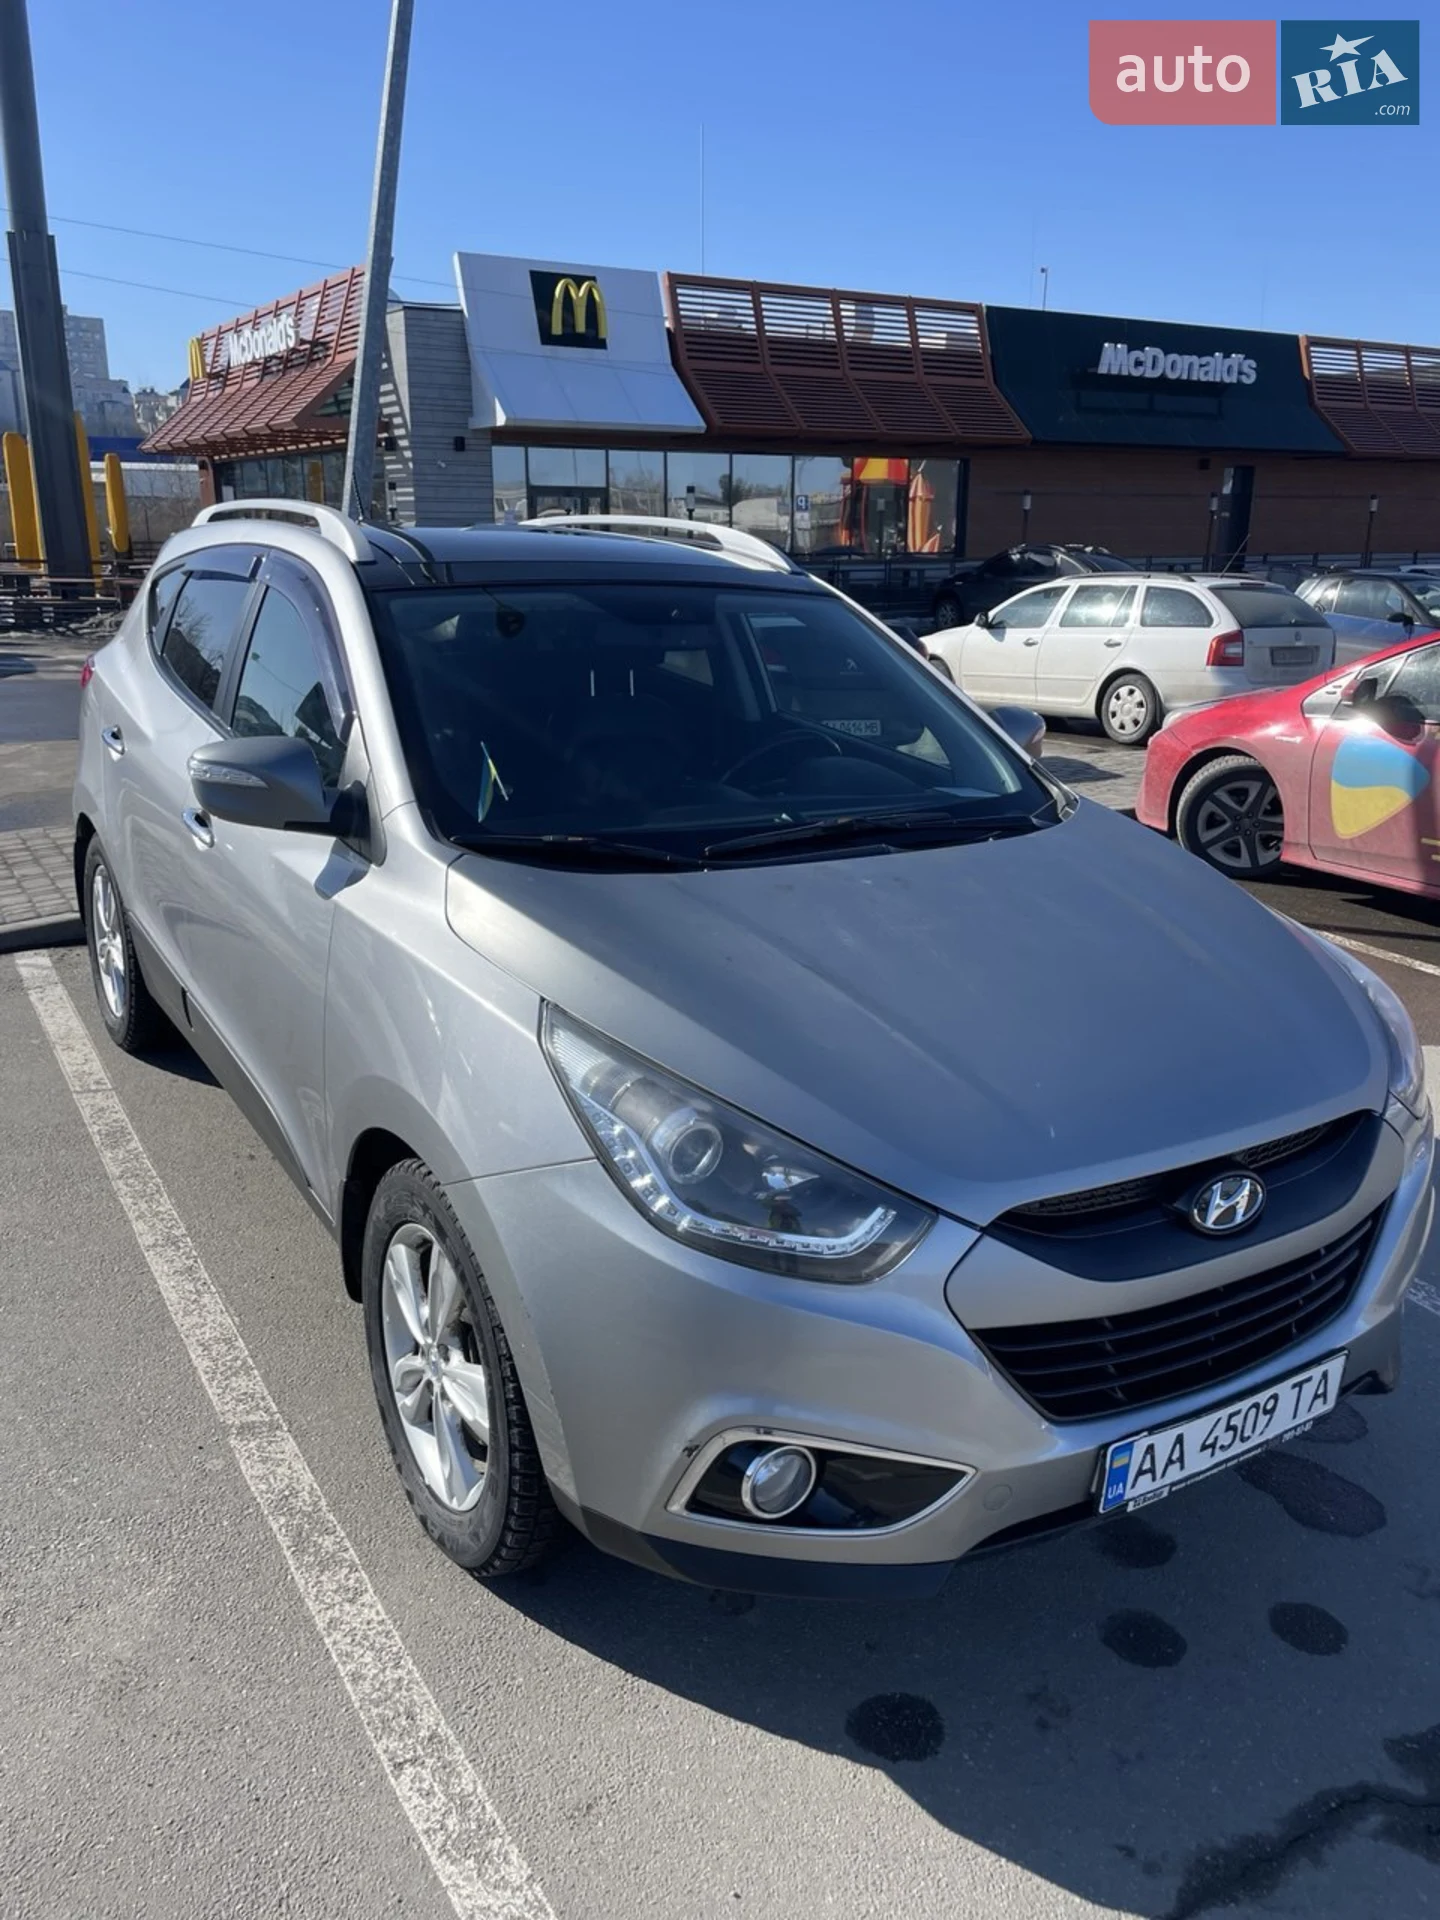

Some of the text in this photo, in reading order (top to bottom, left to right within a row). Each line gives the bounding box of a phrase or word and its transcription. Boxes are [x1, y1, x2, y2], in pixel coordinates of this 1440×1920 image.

[228, 313, 296, 367] McDonald's
[1097, 342, 1257, 384] McDonald's
[1130, 1368, 1329, 1490] AA 4509 TA
[1107, 1484, 1124, 1499] UA
